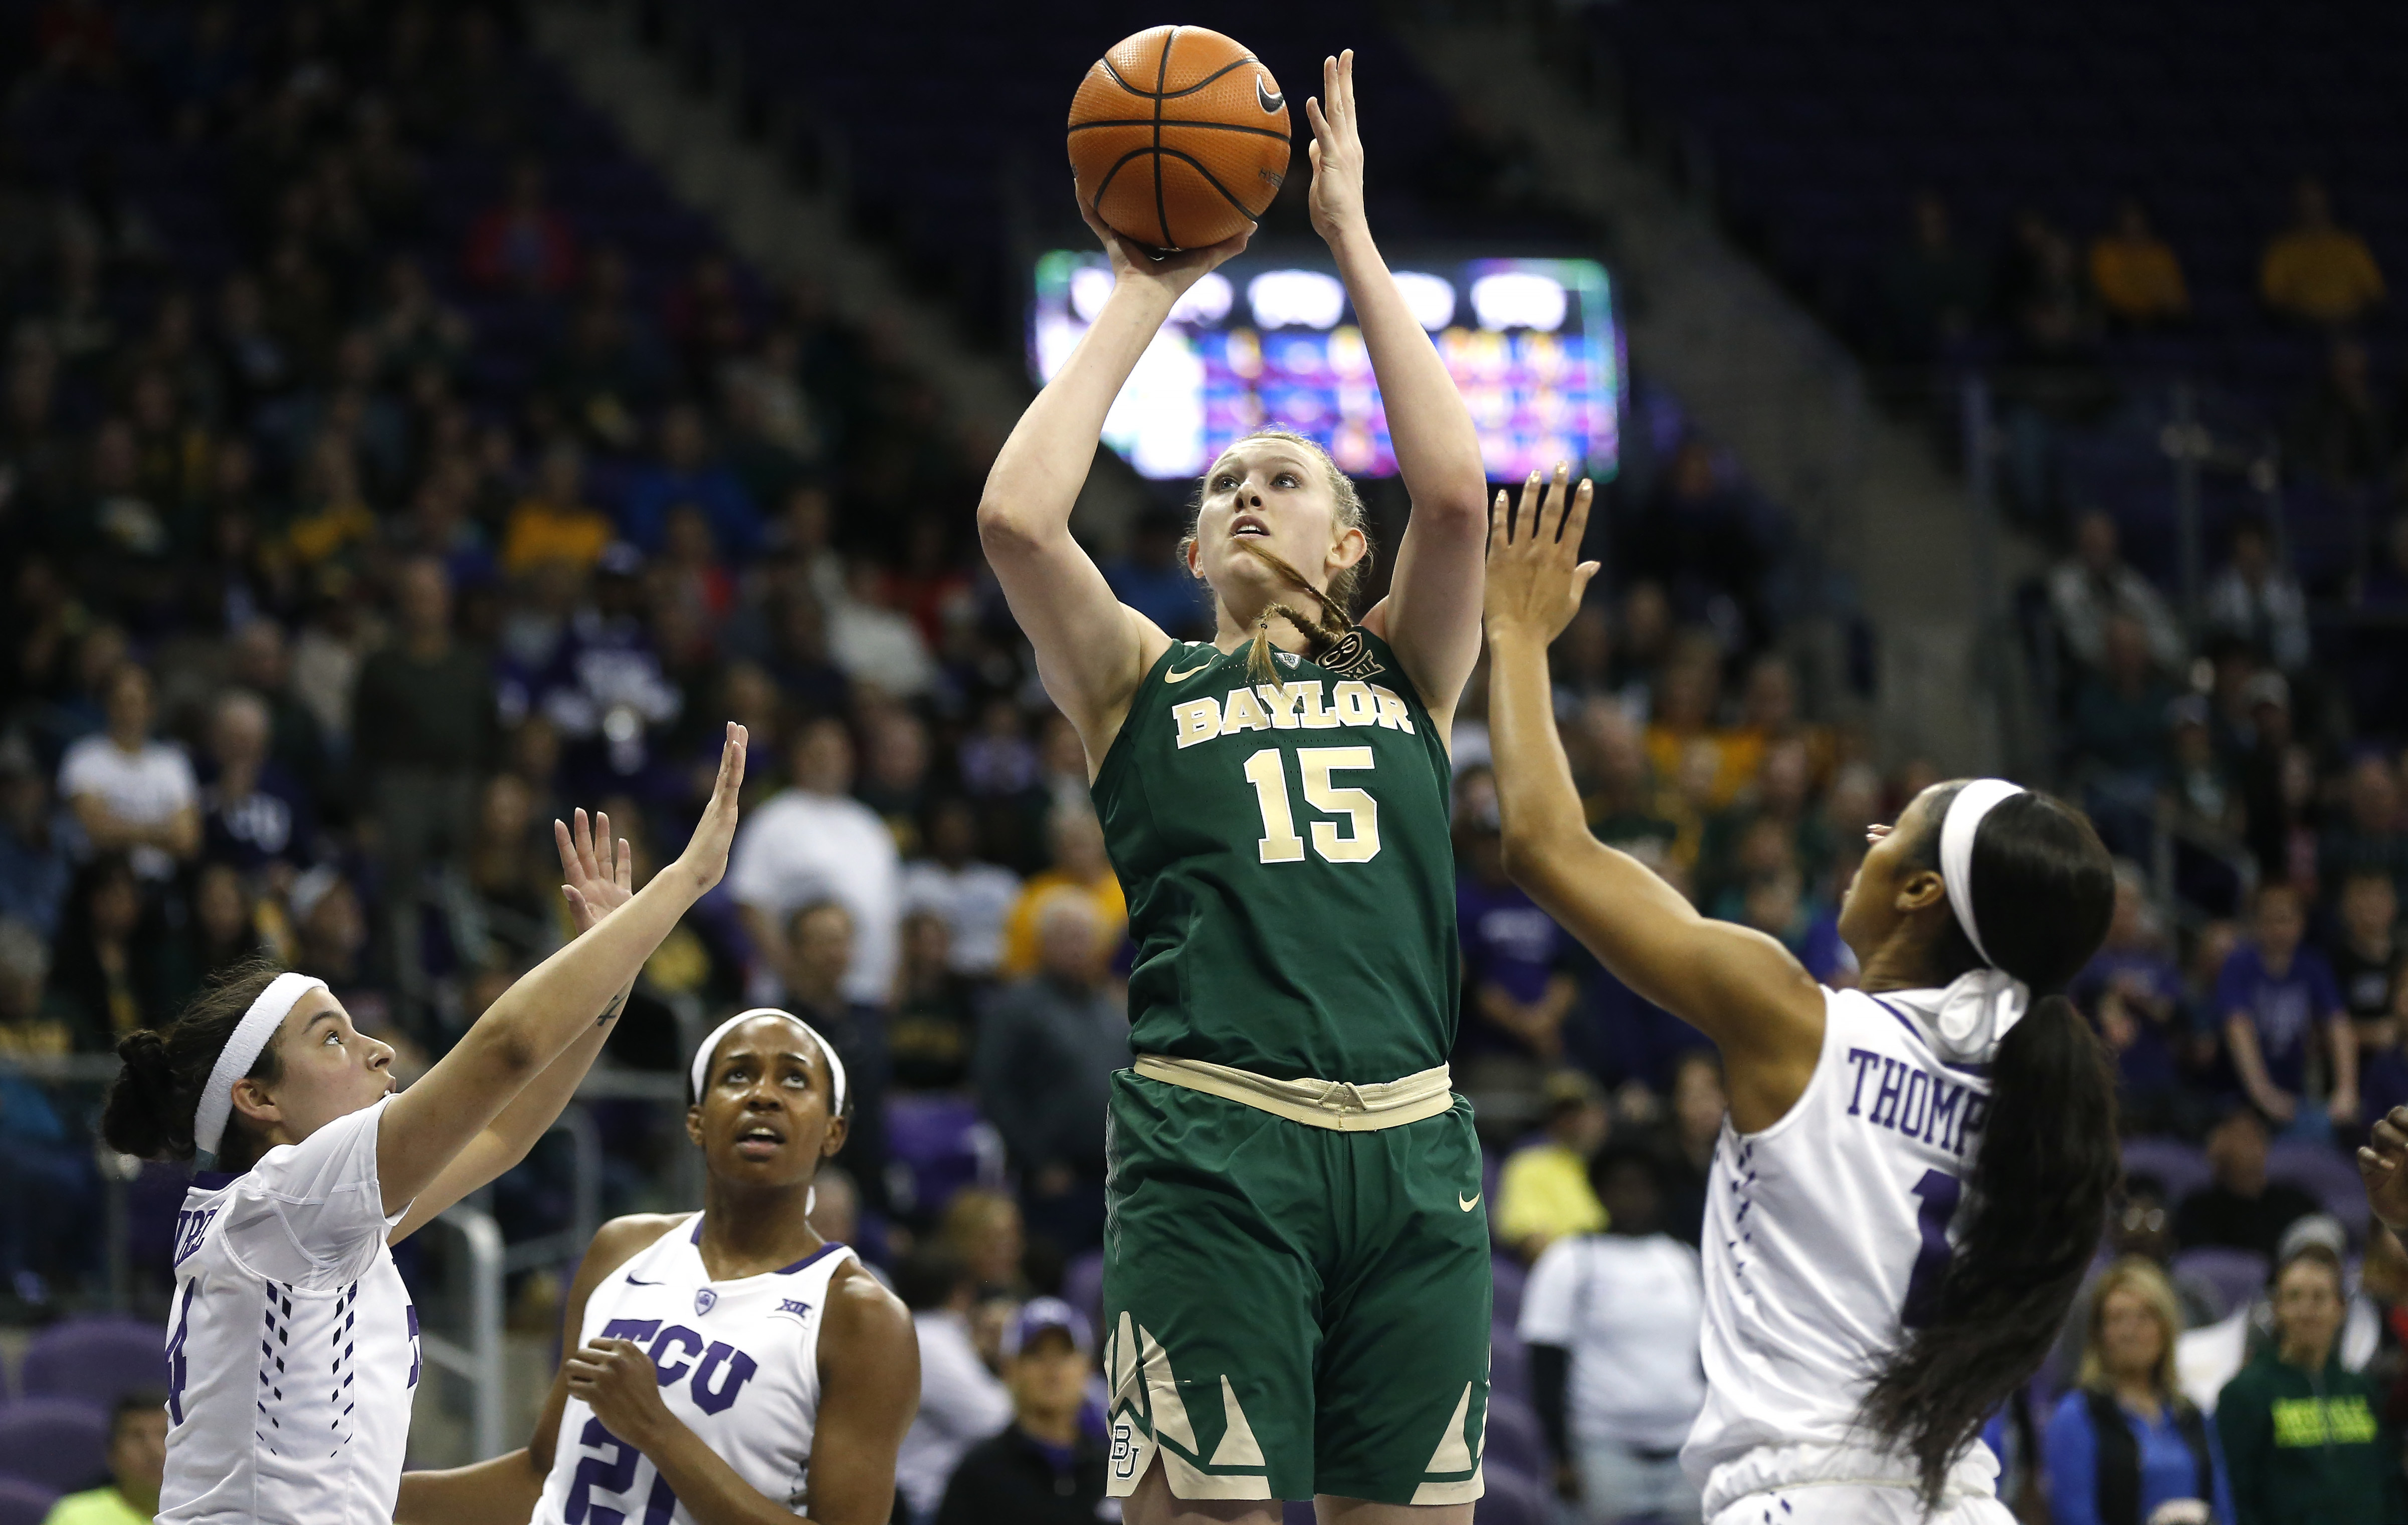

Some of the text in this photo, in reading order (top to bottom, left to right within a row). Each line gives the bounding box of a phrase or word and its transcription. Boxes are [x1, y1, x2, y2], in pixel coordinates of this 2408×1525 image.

[1171, 680, 1416, 749] BAYLOR
[1243, 746, 1381, 863] 15
[1847, 1047, 1989, 1156] THOMP
[774, 1298, 813, 1319] XII
[600, 1319, 758, 1416] TCU
[1110, 1423, 1141, 1480] BU
